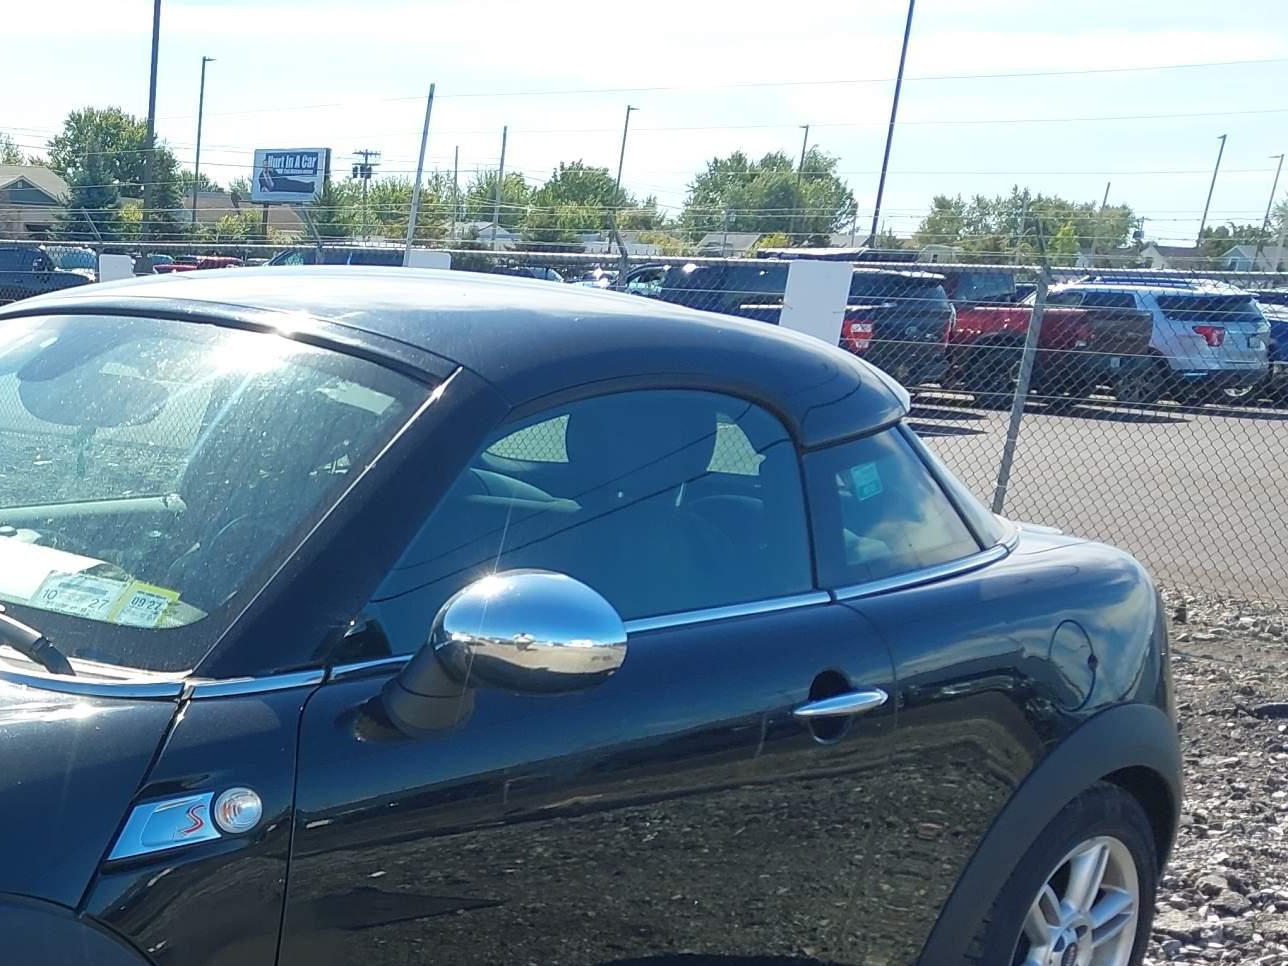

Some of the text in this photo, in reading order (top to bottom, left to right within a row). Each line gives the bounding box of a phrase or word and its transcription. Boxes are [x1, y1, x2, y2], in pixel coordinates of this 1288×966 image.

[267, 154, 317, 168] Hurt In A Car
[42, 588, 58, 600] 10
[87, 599, 110, 612] 27
[183, 804, 206, 836] S
